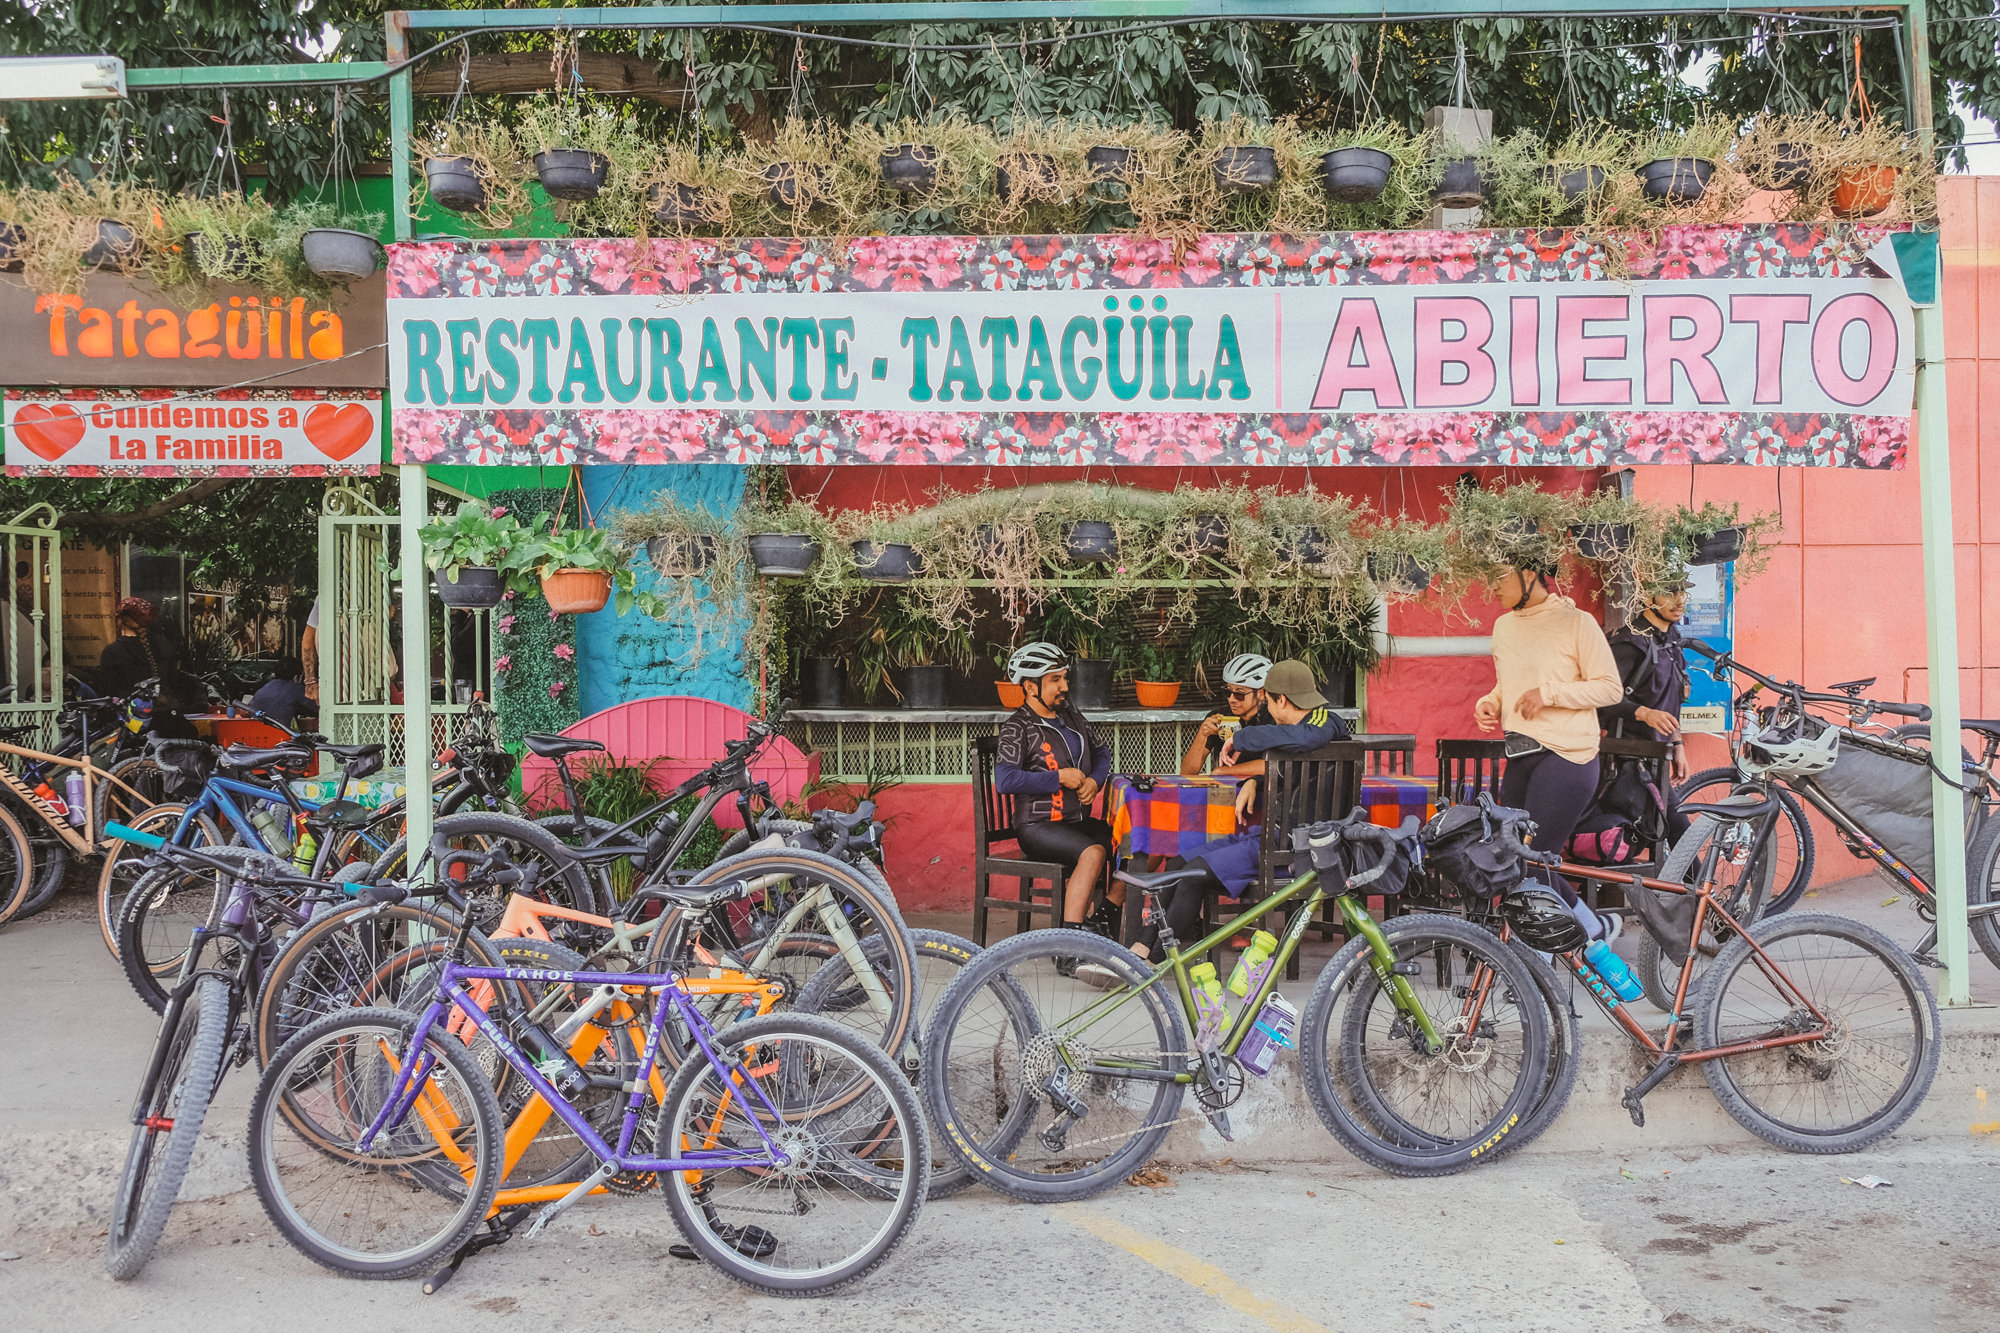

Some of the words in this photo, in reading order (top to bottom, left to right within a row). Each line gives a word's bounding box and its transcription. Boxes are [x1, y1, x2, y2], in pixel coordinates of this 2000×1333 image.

[34, 293, 344, 360] Tatagüila
[402, 316, 859, 406] RESTAURANTE
[1308, 292, 1899, 410] ABIERTO
[91, 403, 269, 429] Cuidemos
[278, 407, 298, 428] a
[109, 435, 147, 460] La
[155, 435, 283, 460] Familia
[22, 539, 85, 551] QUEATE
[0, 764, 71, 830] PECIALIZED
[500, 948, 550, 960] AXXIS
[924, 941, 972, 960] MAXX
[504, 967, 574, 981] TAHOE
[1578, 964, 1619, 1010] STATE
[481, 1019, 516, 1056] FUJI
[945, 1121, 993, 1173] MAXXIS
[1470, 1112, 1519, 1158] MAXXIS
